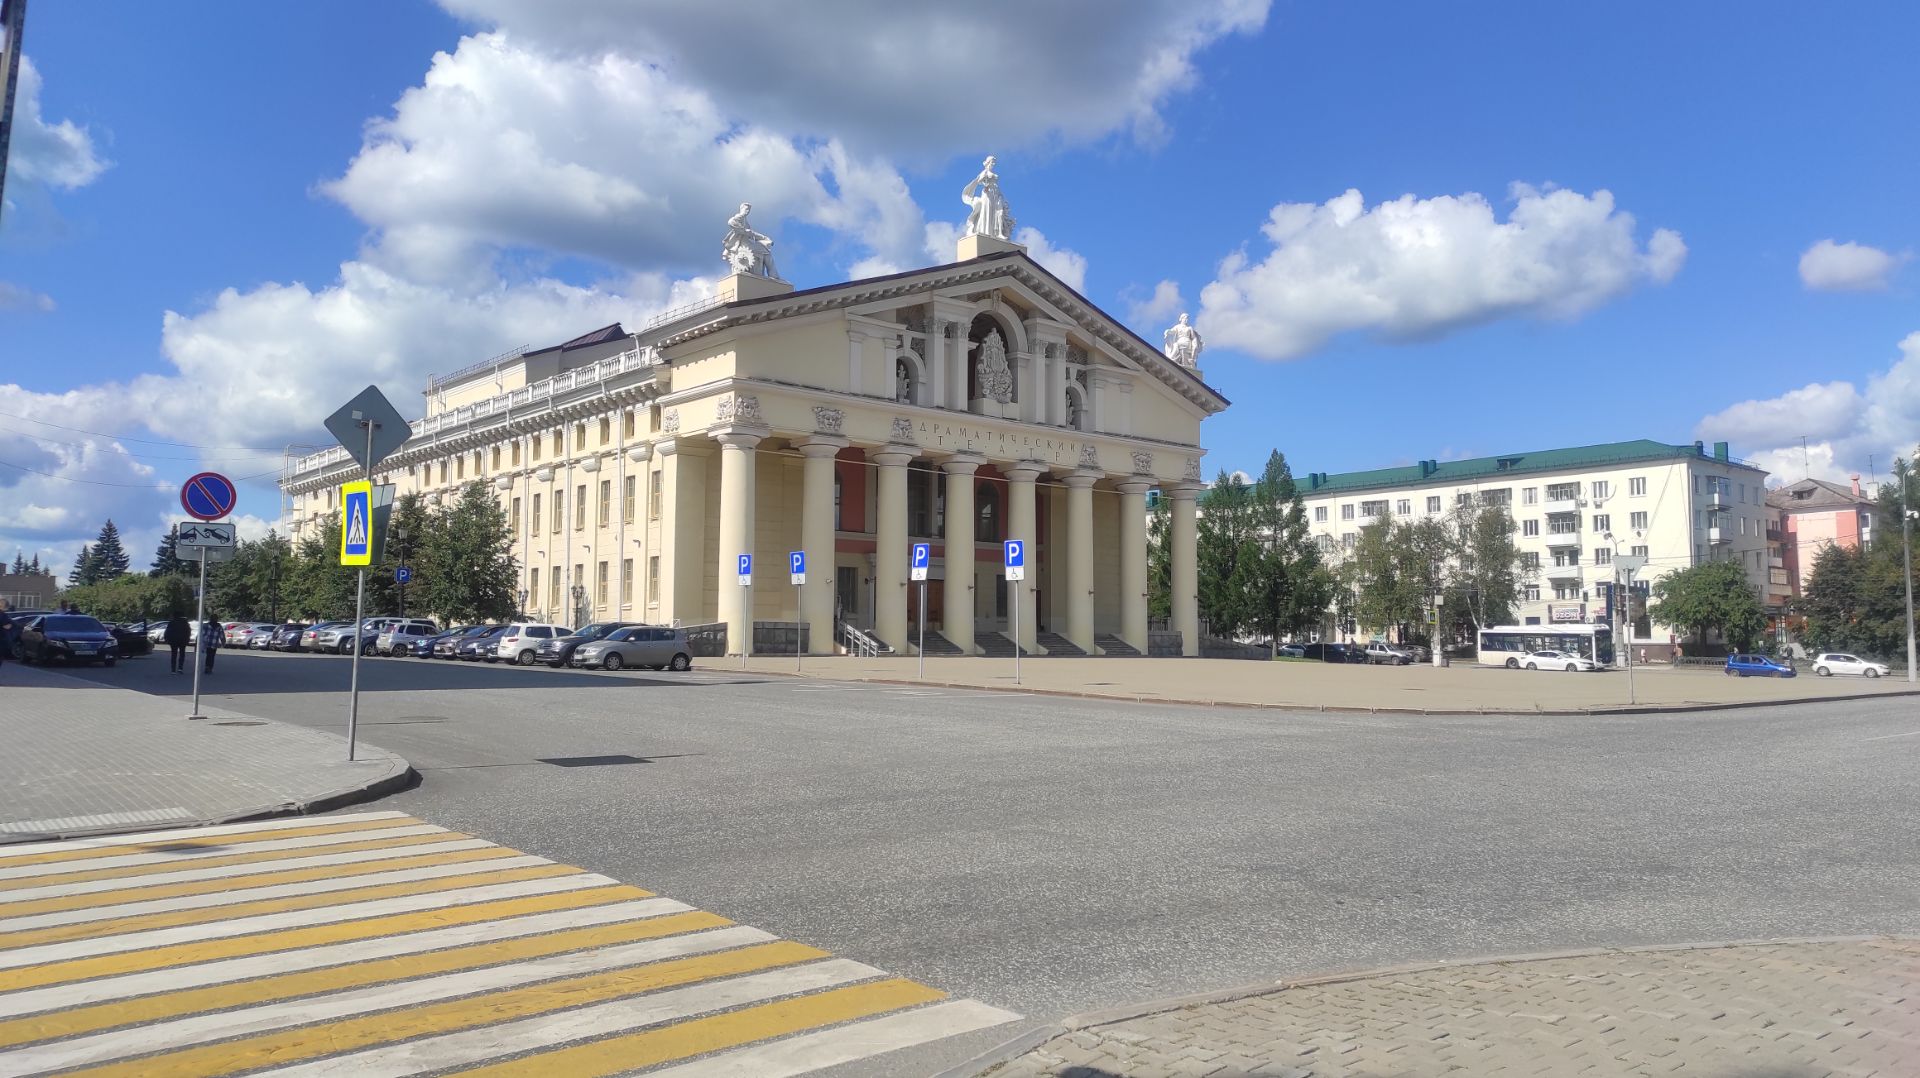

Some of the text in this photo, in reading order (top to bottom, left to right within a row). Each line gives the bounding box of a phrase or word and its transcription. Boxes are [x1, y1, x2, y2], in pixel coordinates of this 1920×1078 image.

[916, 546, 925, 567] P
[1008, 542, 1019, 564] P
[740, 556, 748, 572] P
[793, 555, 802, 572] P
[399, 569, 408, 581] P
